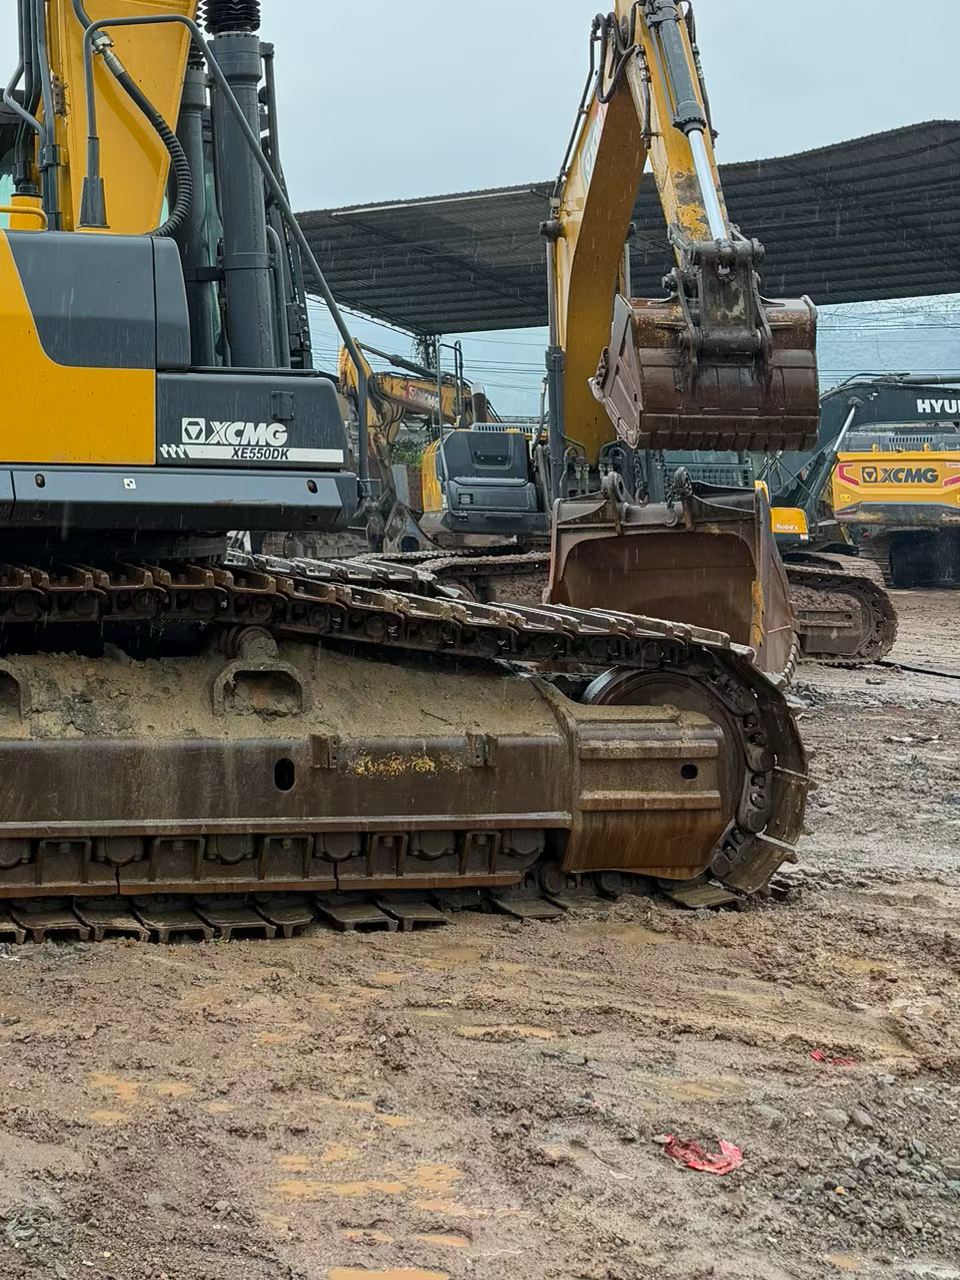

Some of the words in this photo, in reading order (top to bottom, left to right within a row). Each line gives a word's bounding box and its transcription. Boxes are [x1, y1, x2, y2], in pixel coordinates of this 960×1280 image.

[916, 399, 960, 414] HYU
[205, 421, 288, 446] XCMG
[231, 447, 289, 460] XE550DK
[879, 467, 938, 484] XCMG
